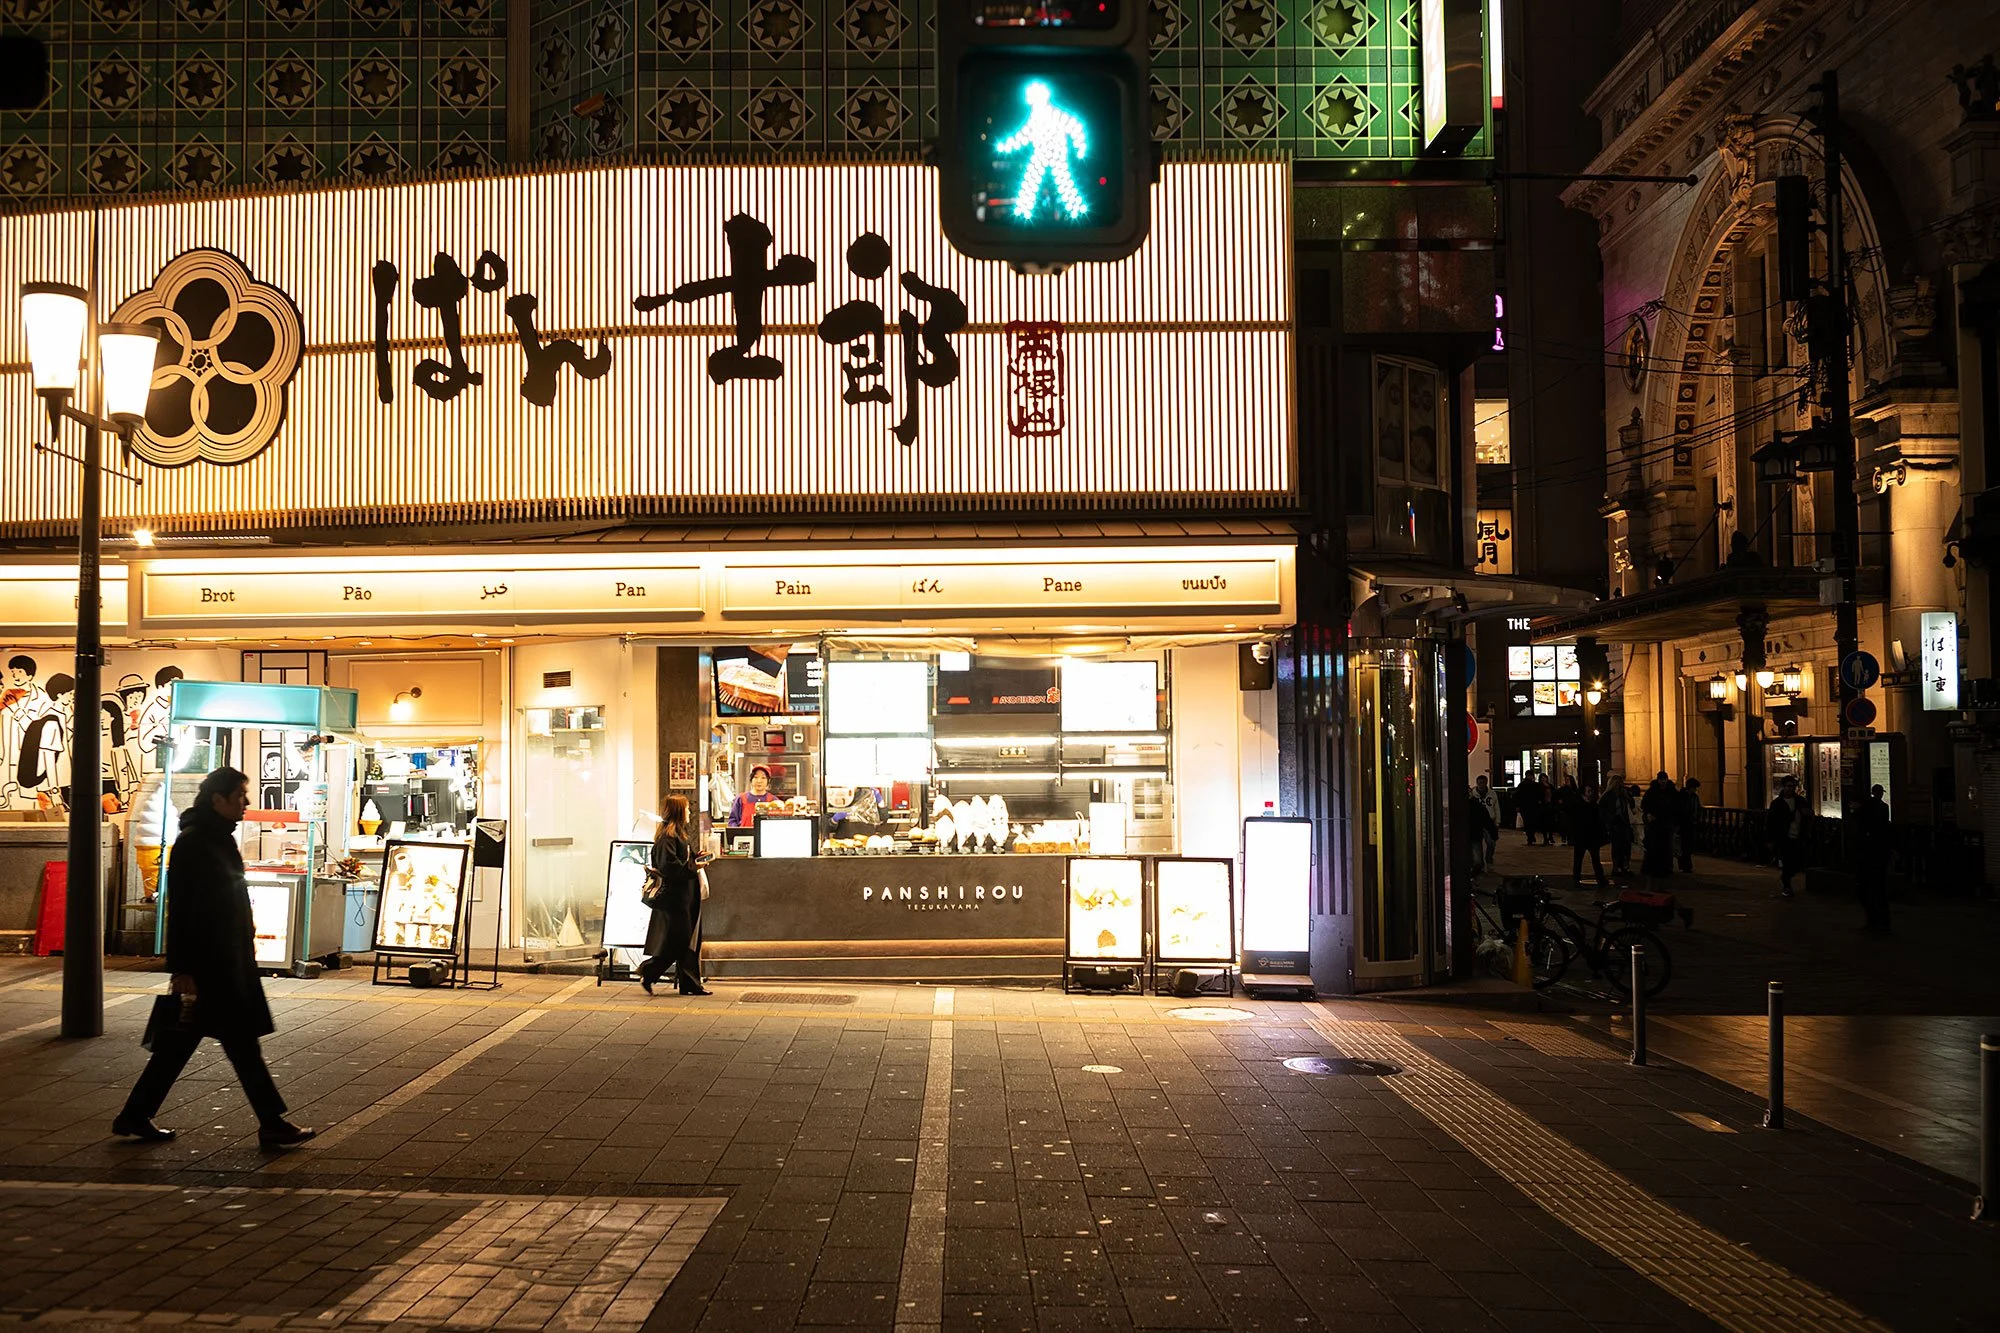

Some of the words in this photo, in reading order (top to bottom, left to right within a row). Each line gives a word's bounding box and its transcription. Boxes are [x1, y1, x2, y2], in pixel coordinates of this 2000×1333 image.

[1477, 519, 1510, 565] 風月
[616, 583, 646, 596] Pan
[776, 581, 811, 595] Pain
[1044, 578, 1081, 592] Pane
[1182, 575, 1227, 590] ขนมปัง
[201, 588, 235, 602] Brot
[343, 586, 372, 600] Pão
[480, 583, 508, 600] خبز
[1507, 618, 1530, 630] THE
[1931, 637, 1947, 692] はり重
[863, 885, 1023, 901] PANSHIROU
[907, 903, 979, 911] TEZUKAYAMA
